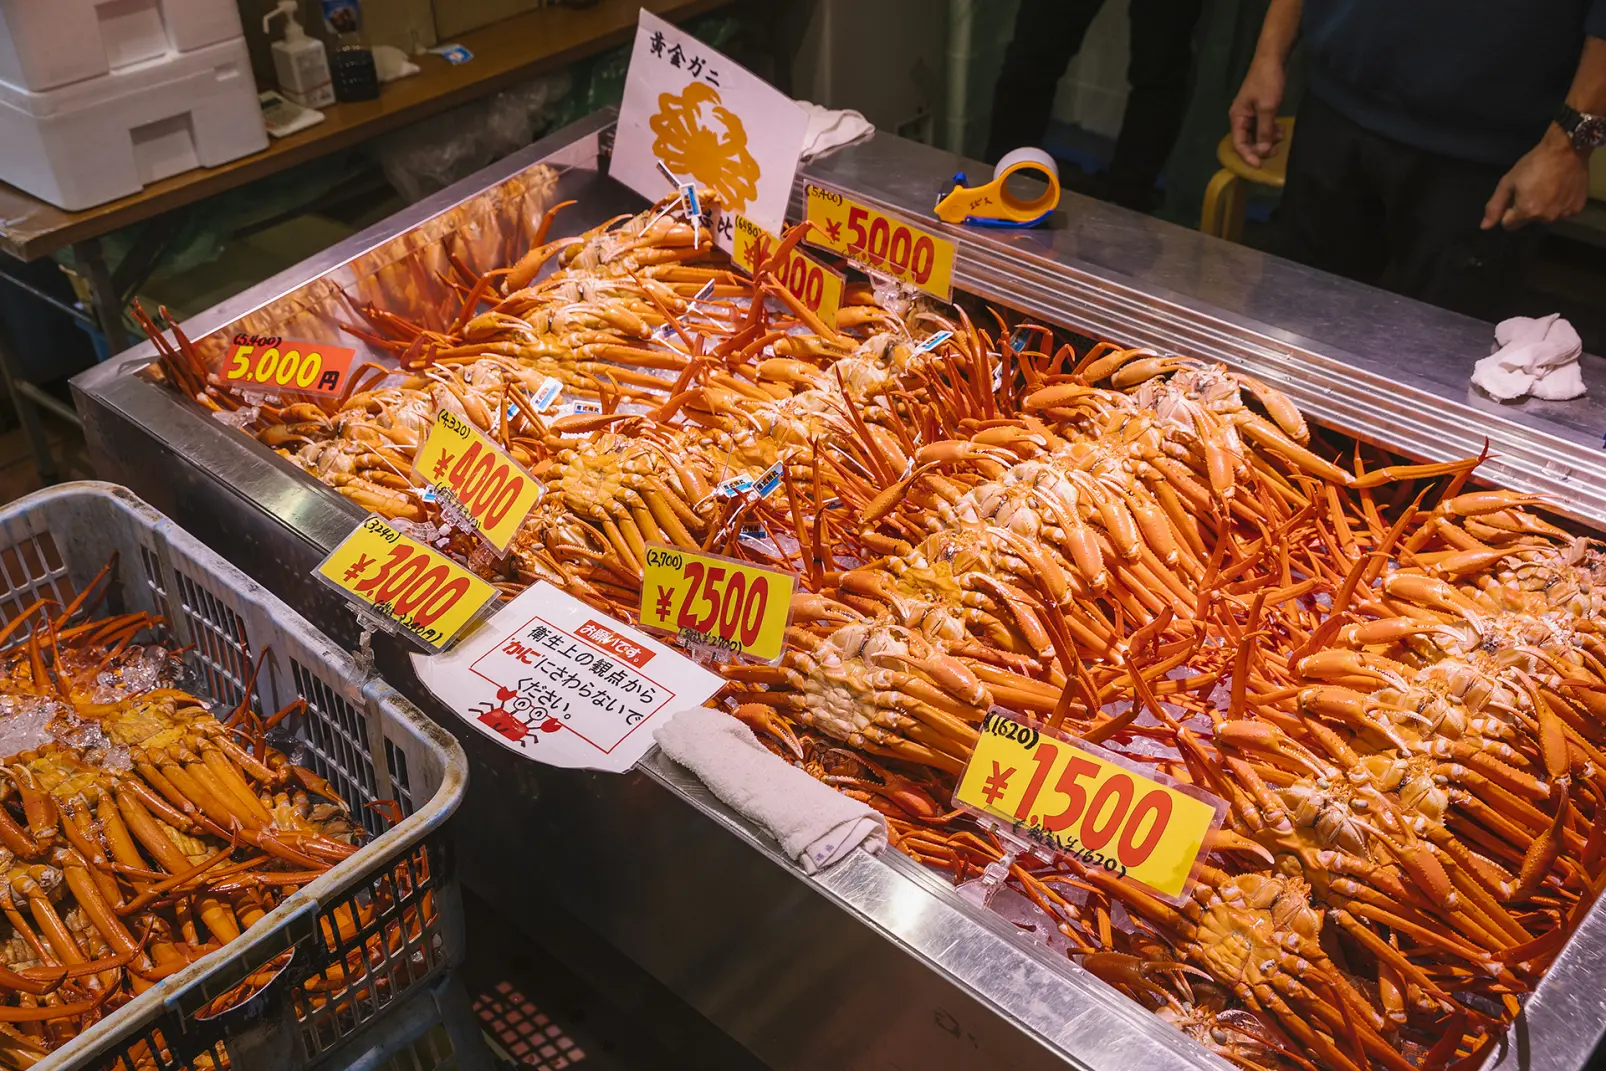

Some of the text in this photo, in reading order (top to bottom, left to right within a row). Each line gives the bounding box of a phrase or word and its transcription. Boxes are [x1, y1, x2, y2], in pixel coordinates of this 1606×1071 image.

[650, 31, 720, 87] 黄金ガニ
[227, 345, 340, 391] 5,000円
[437, 408, 471, 440] (4,320)
[363, 516, 402, 544] (3,240)
[646, 549, 683, 570] (2,700)
[526, 625, 656, 704] 衛生上の観点から
[578, 621, 642, 665] お願いです。
[517, 677, 572, 721] ください。
